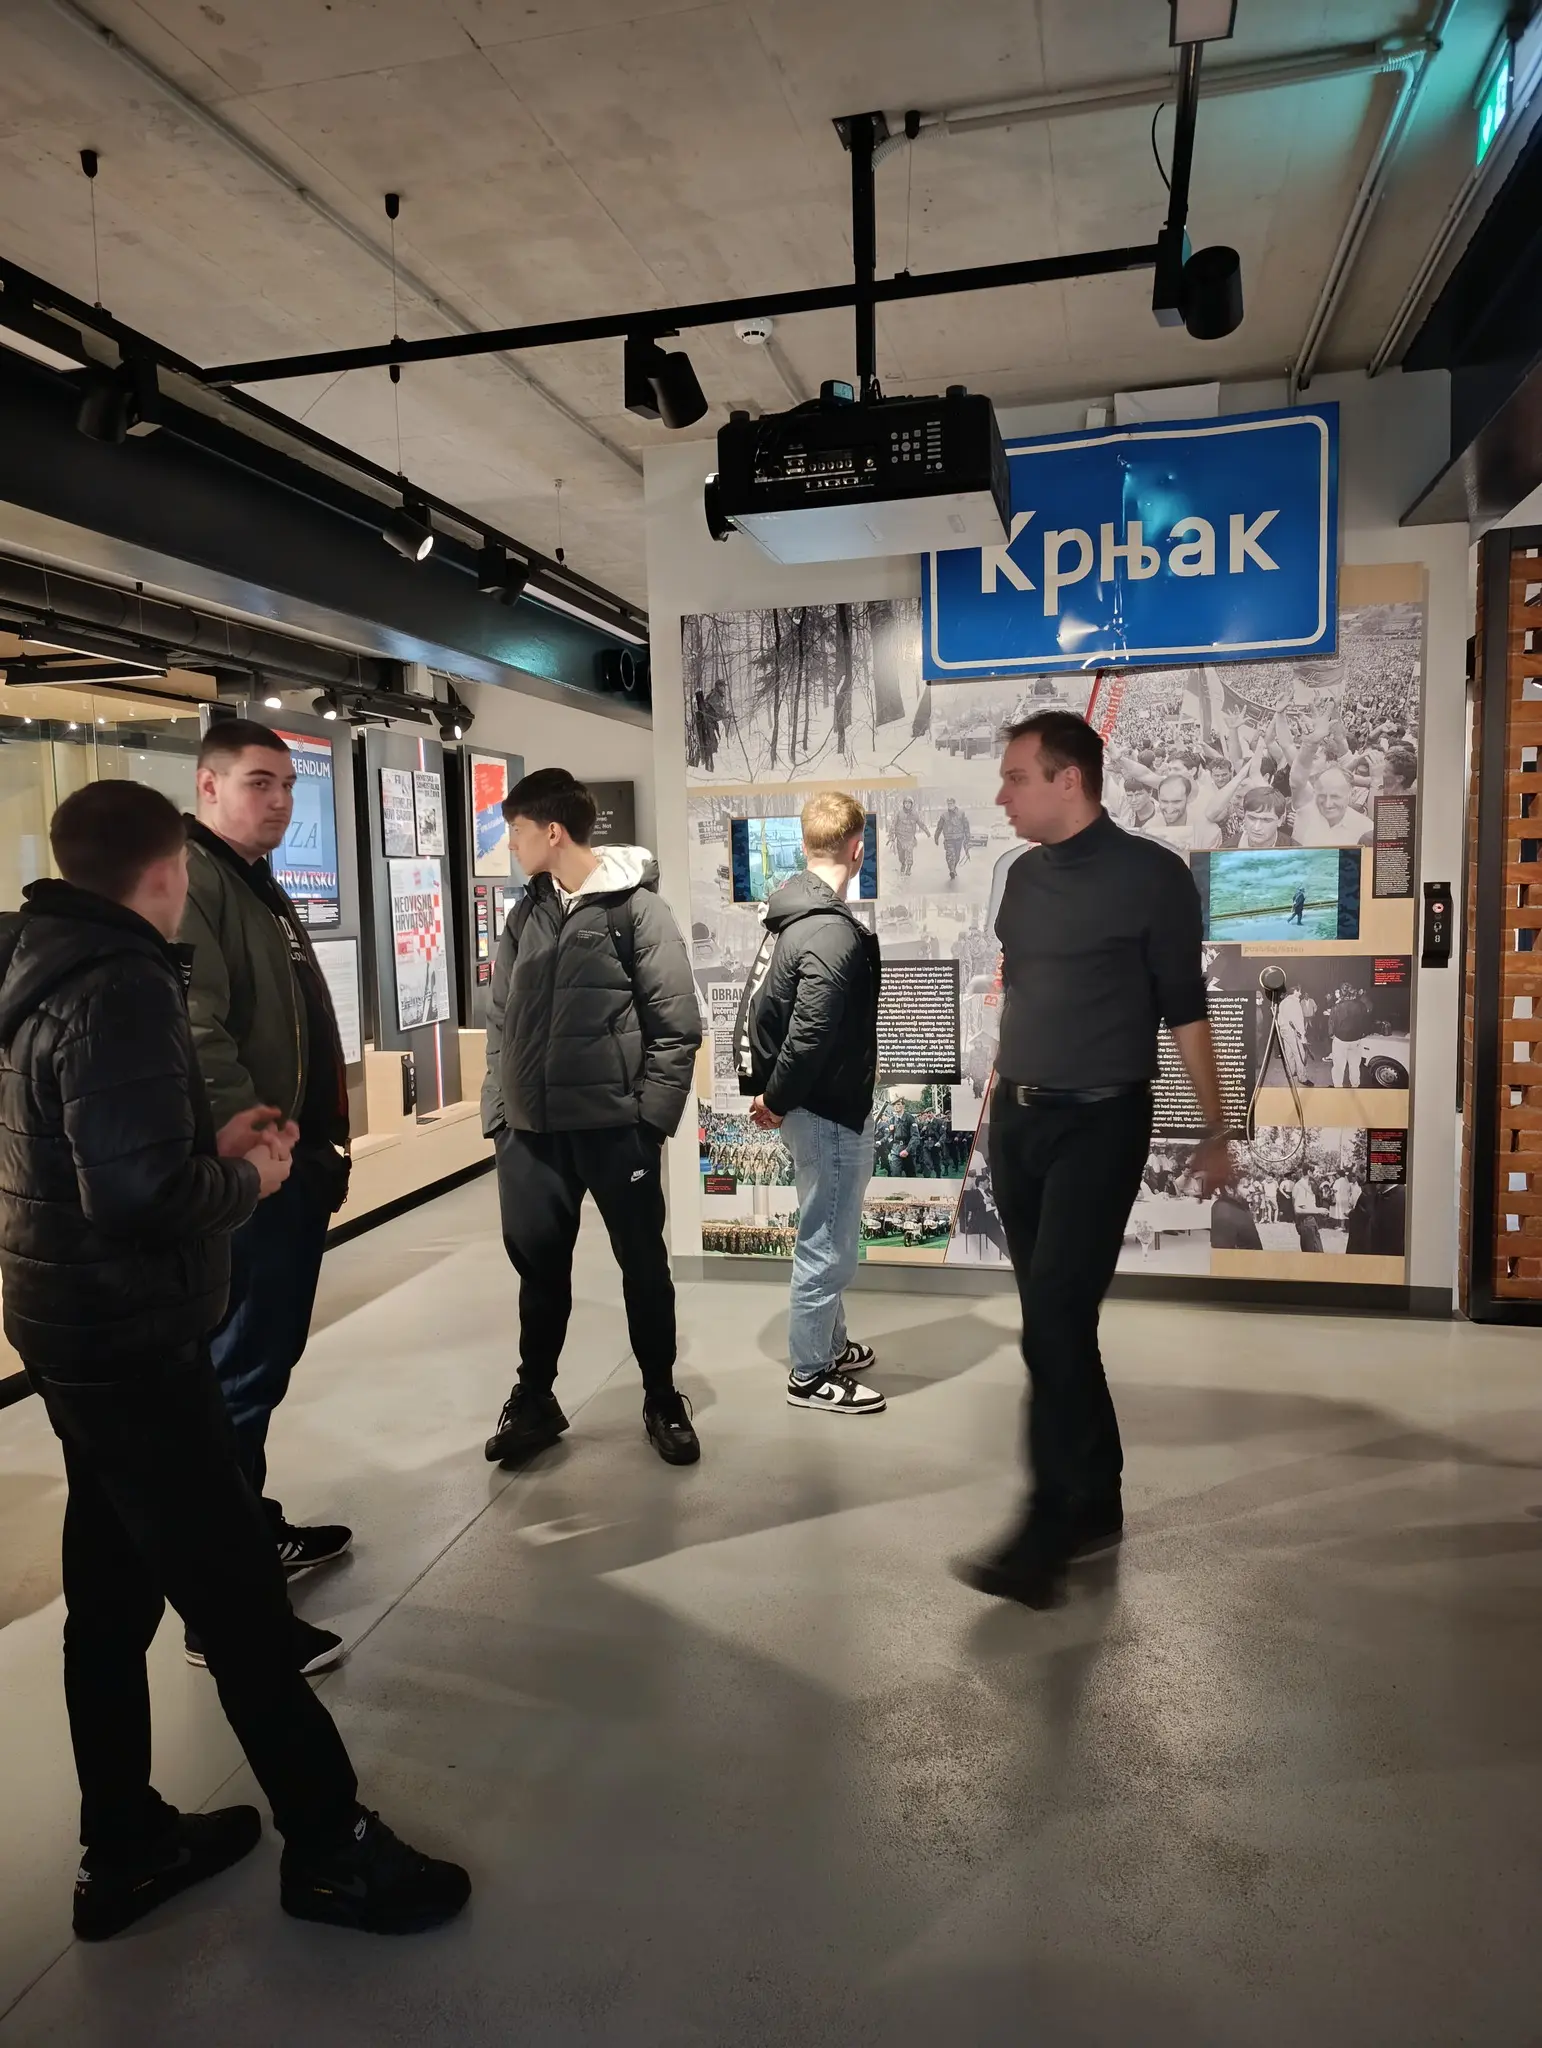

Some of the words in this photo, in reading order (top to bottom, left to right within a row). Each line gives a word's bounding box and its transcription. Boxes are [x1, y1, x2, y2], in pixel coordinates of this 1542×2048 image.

[981, 509, 1281, 616] Крњак
[292, 758, 331, 778] RENDUM
[289, 821, 317, 849] ZA
[276, 870, 336, 888] HRVATSKU
[394, 894, 432, 913] NEOVISNA
[396, 911, 434, 931] HRVATSKA
